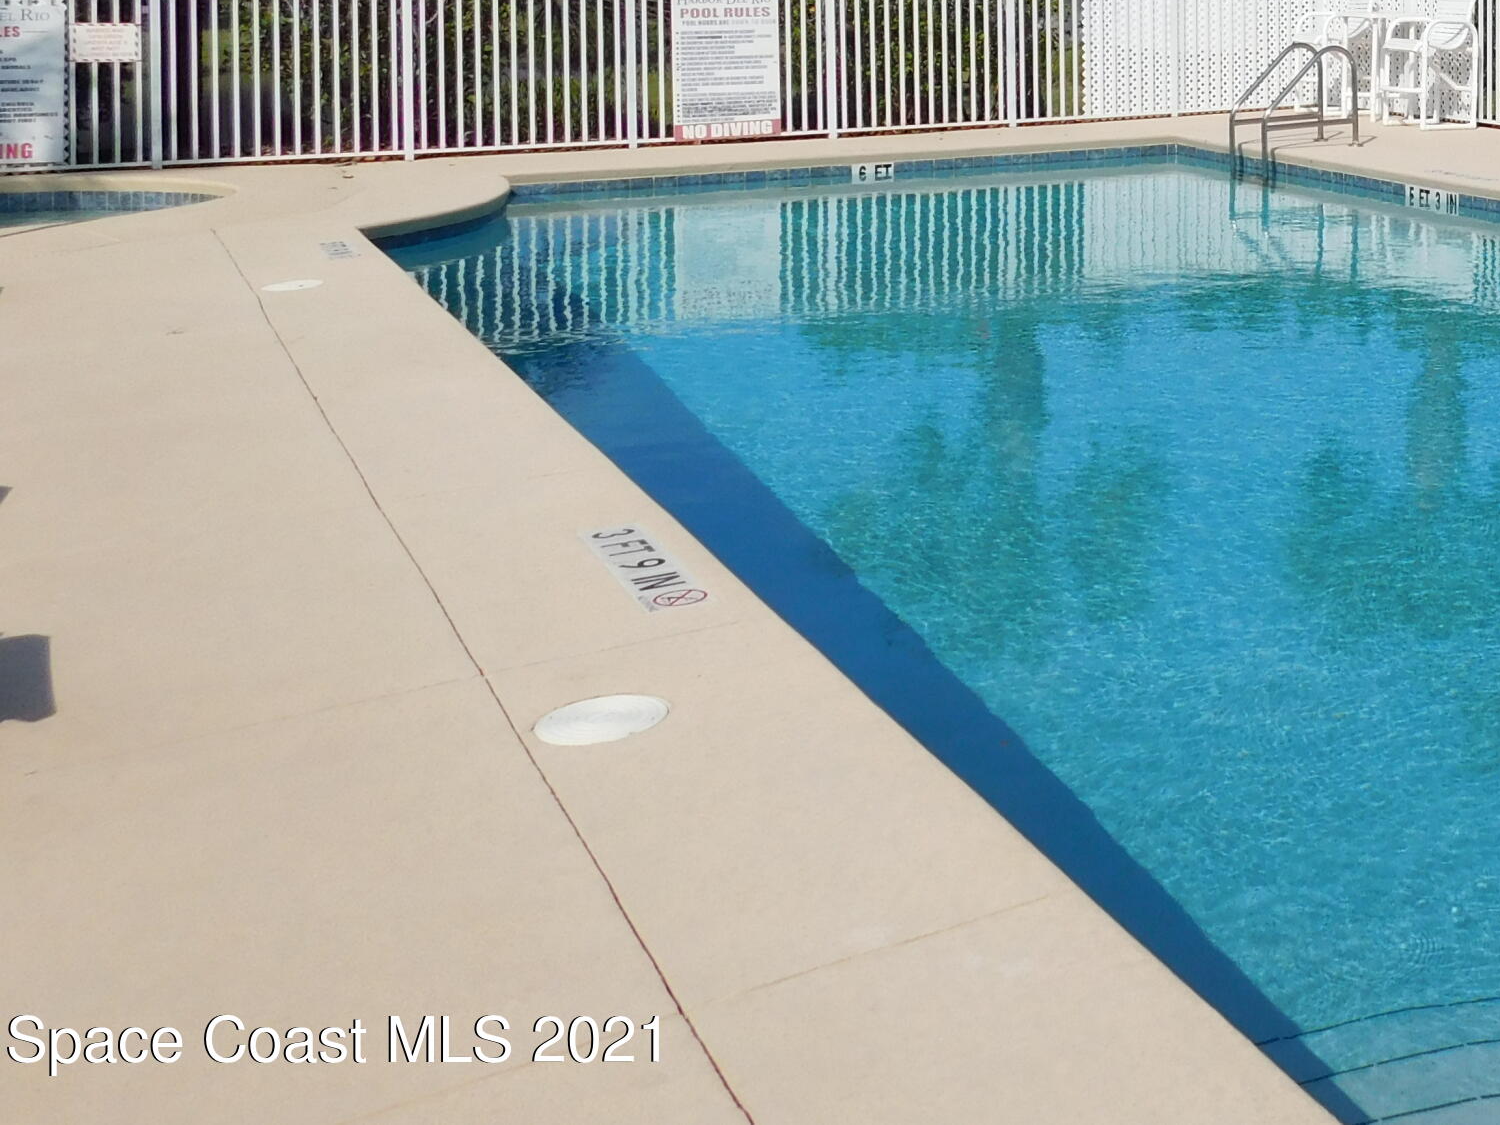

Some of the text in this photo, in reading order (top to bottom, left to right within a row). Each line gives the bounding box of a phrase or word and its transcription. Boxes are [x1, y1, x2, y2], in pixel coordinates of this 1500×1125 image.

[20, 9, 50, 21] RIO
[680, 6, 771, 18] POOL RULES
[682, 120, 773, 139] NO DIVING
[591, 528, 635, 539] 3
[600, 539, 656, 557] FT
[618, 558, 666, 568] 9
[630, 571, 687, 591] IN
